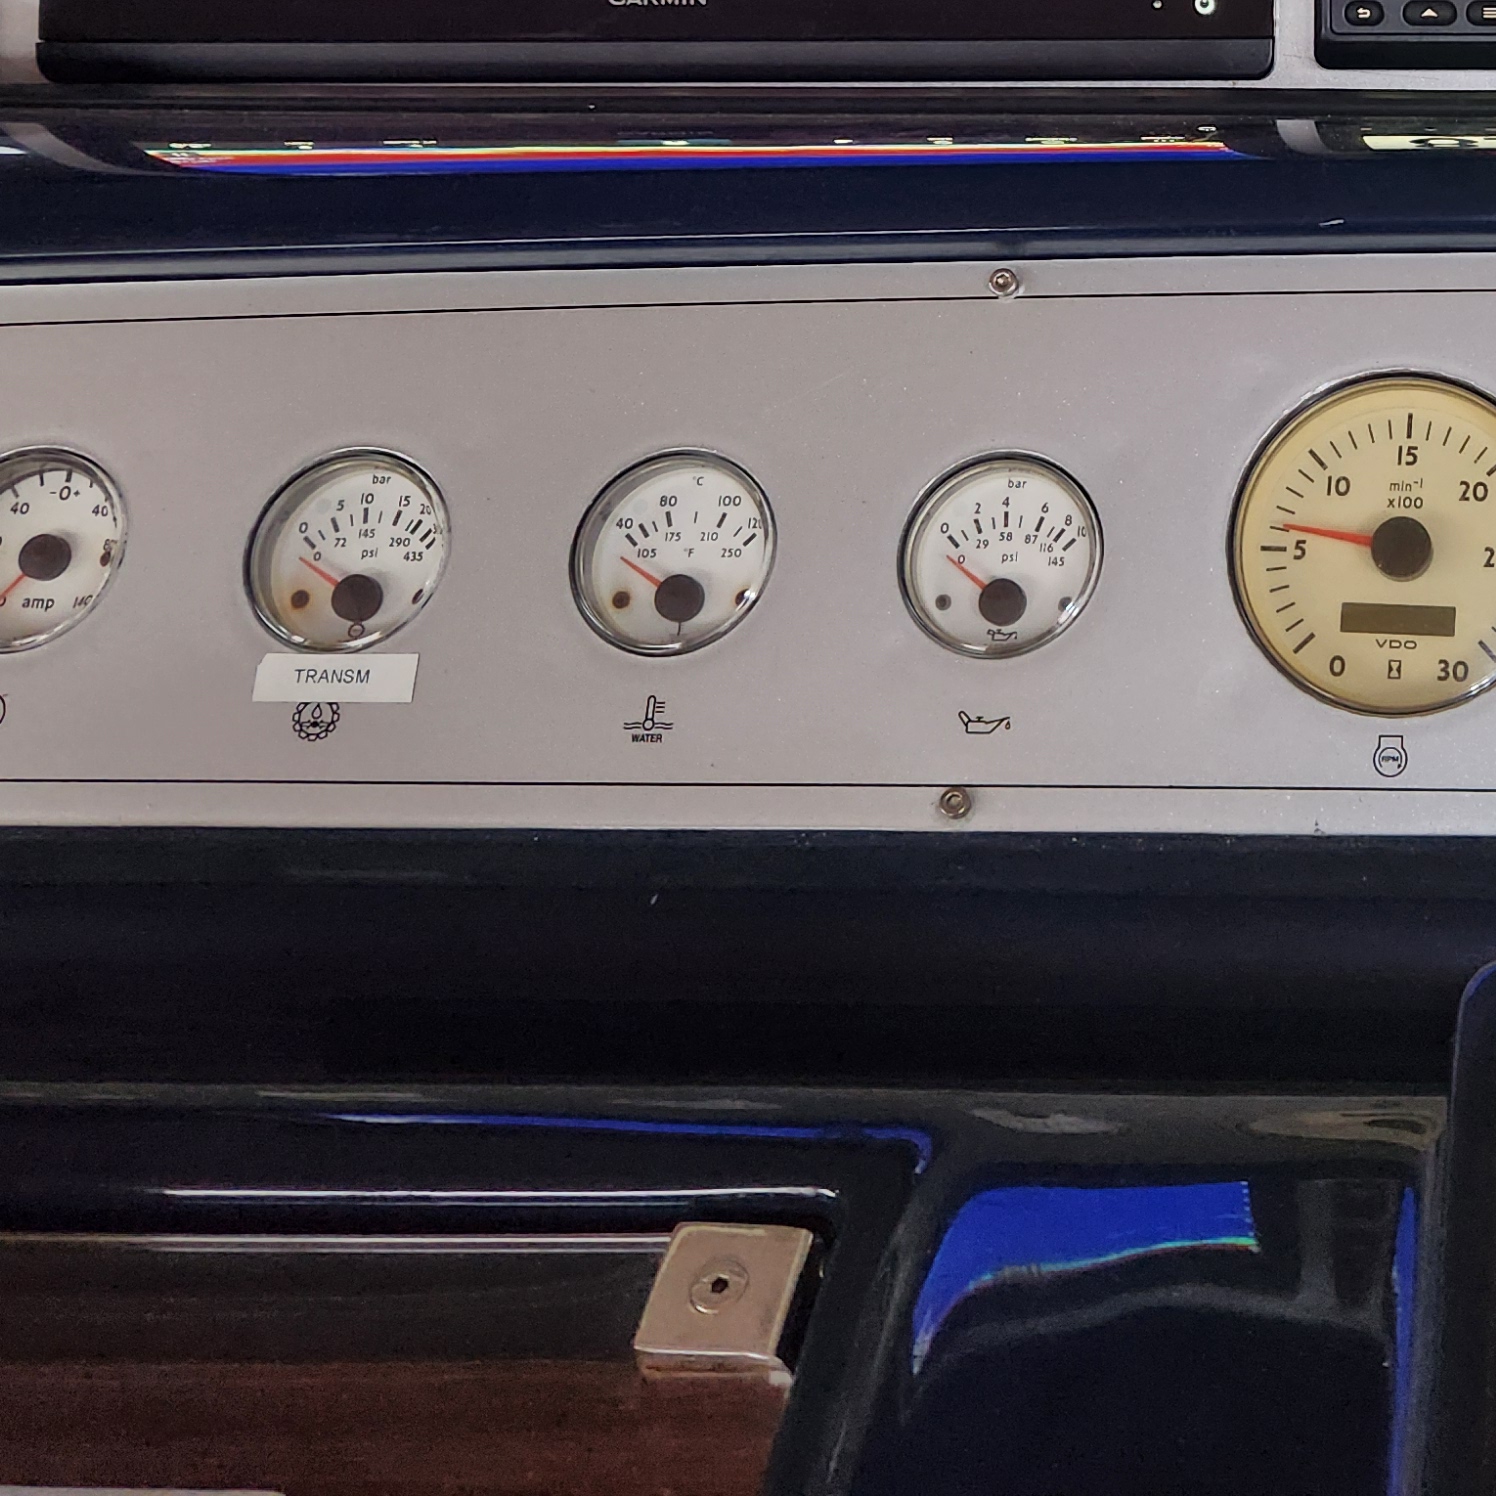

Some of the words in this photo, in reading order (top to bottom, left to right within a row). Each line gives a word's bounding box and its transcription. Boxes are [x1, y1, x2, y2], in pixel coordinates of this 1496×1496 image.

[1397, 444, 1418, 467] 15
[372, 474, 392, 485] bar
[1008, 478, 1027, 489] bar
[1326, 475, 1351, 497] 10
[1458, 480, 1489, 503] 20
[360, 493, 374, 505] 10
[399, 495, 411, 507] 15
[659, 495, 677, 507] 80
[718, 495, 742, 507] 100
[1002, 497, 1010, 508] 4
[10, 502, 30, 515] 40
[92, 504, 109, 517] 40
[336, 499, 345, 512] 5
[419, 503, 432, 515] 20
[974, 502, 982, 514] 2
[1041, 502, 1049, 514] 6
[616, 518, 634, 529] 40
[1064, 514, 1073, 526] 8
[299, 521, 308, 534] 0
[358, 528, 376, 539] 145
[940, 522, 950, 534] 0
[334, 537, 347, 548] 72
[389, 537, 411, 548] 290
[664, 532, 682, 542] 175
[700, 532, 719, 542] 210
[999, 531, 1013, 542] 58
[1024, 534, 1038, 545] 87
[975, 538, 989, 550] 29
[313, 551, 321, 562] 0
[361, 548, 378, 560] psi
[403, 551, 423, 562] 435
[637, 548, 657, 558] 105
[721, 548, 742, 558] 250
[1293, 540, 1307, 561] 5
[957, 554, 966, 565] 0
[1001, 551, 1019, 564] psi
[1047, 556, 1065, 567] 145
[21, 596, 55, 609] amp
[1375, 638, 1418, 651] VDO
[1329, 654, 1346, 677] 0
[1436, 659, 1469, 683] 30
[294, 669, 370, 684] TRANSM
[631, 733, 663, 744] WATER
